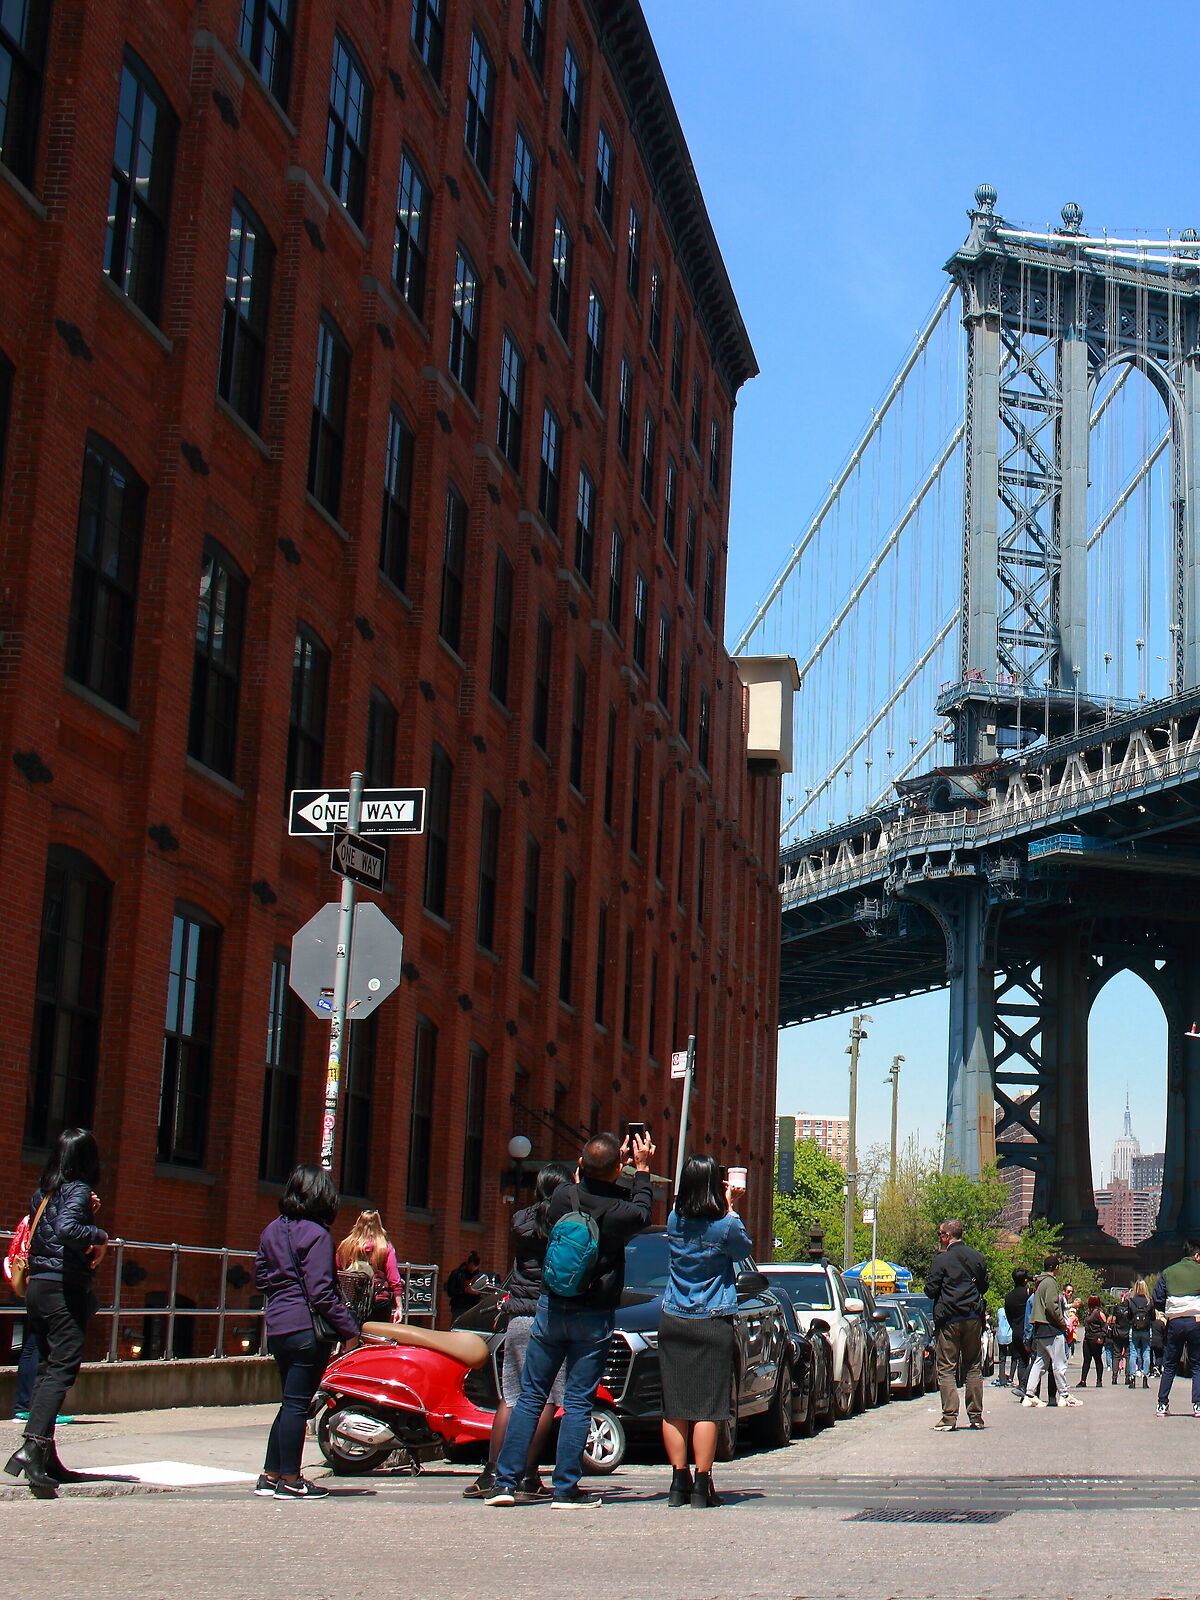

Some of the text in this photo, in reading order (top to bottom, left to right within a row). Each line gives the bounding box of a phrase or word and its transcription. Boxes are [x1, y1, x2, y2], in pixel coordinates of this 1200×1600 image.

[312, 803, 406, 820] ONE WAY
[341, 844, 378, 876] ONE WAY
